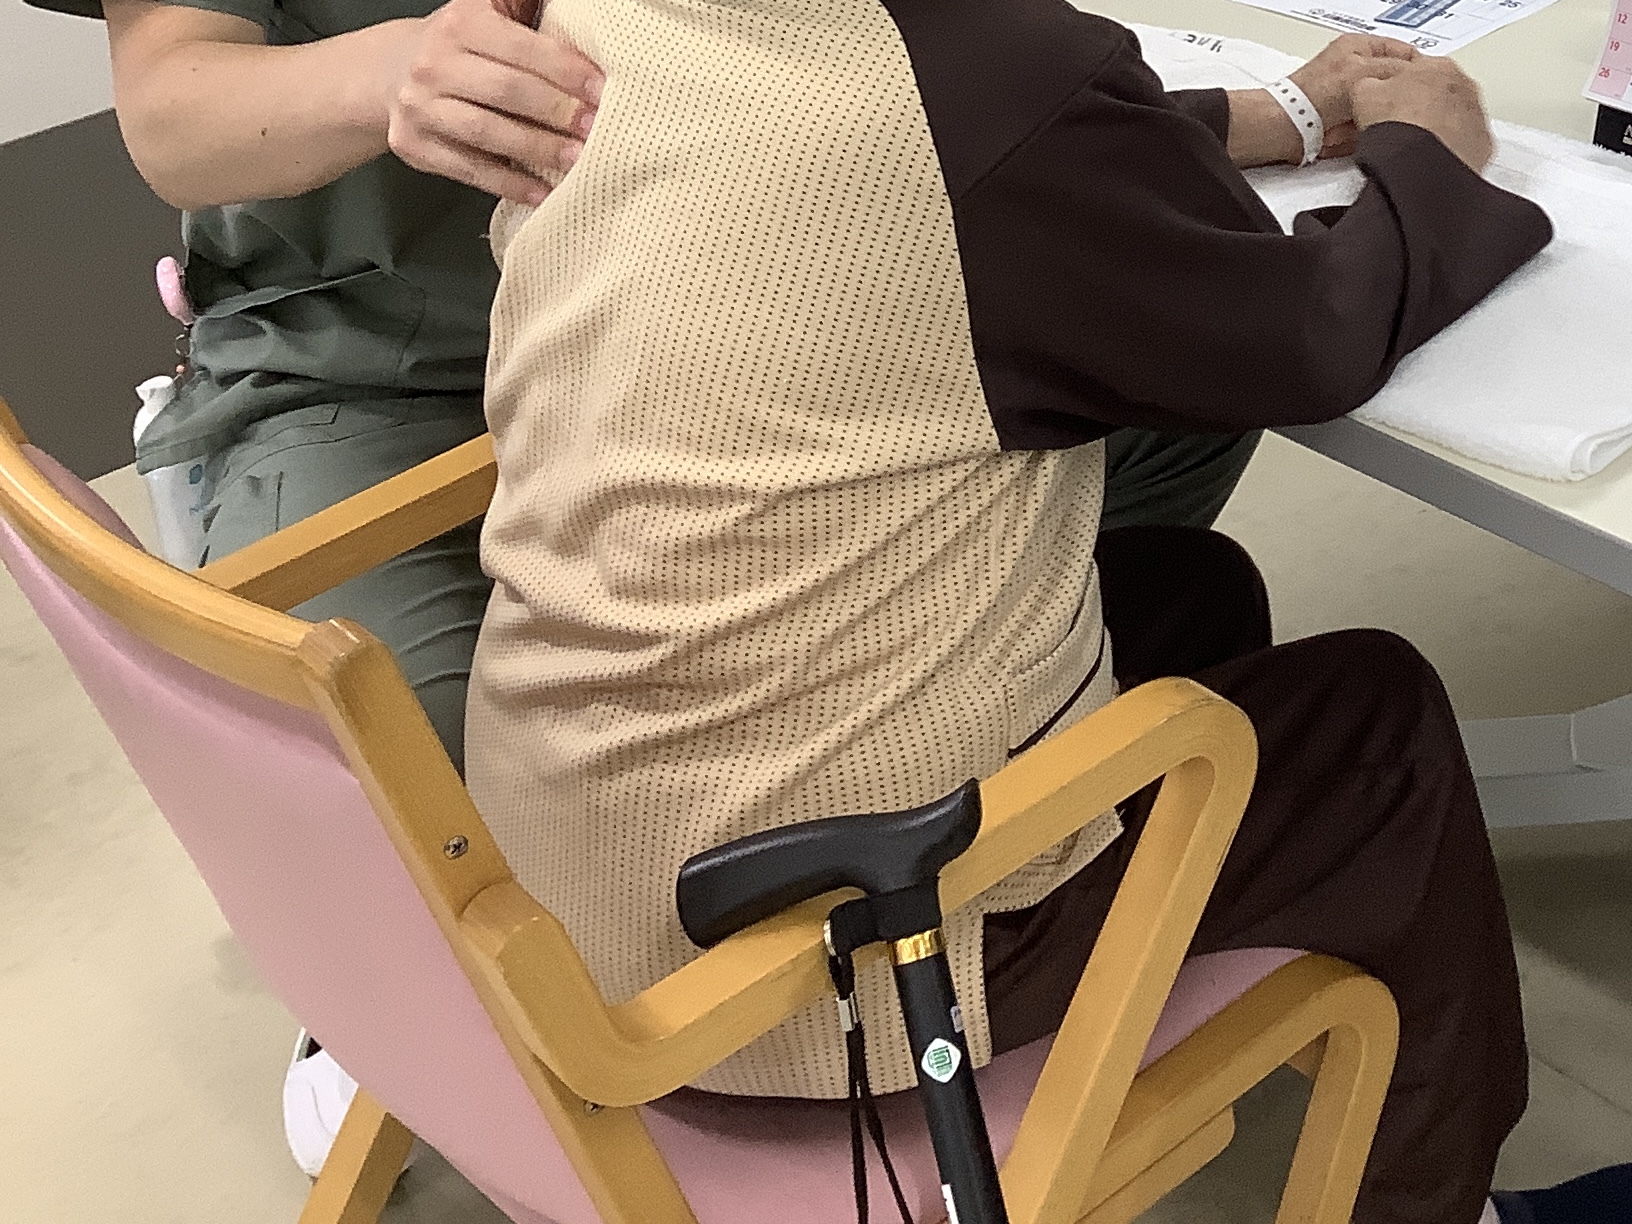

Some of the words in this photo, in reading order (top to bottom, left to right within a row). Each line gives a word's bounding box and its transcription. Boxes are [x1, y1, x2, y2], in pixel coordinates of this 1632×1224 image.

[1499, 0, 1521, 8] 25
[1617, 13, 1628, 24] 12
[1609, 40, 1620, 51] 19
[1598, 67, 1610, 79] 26
